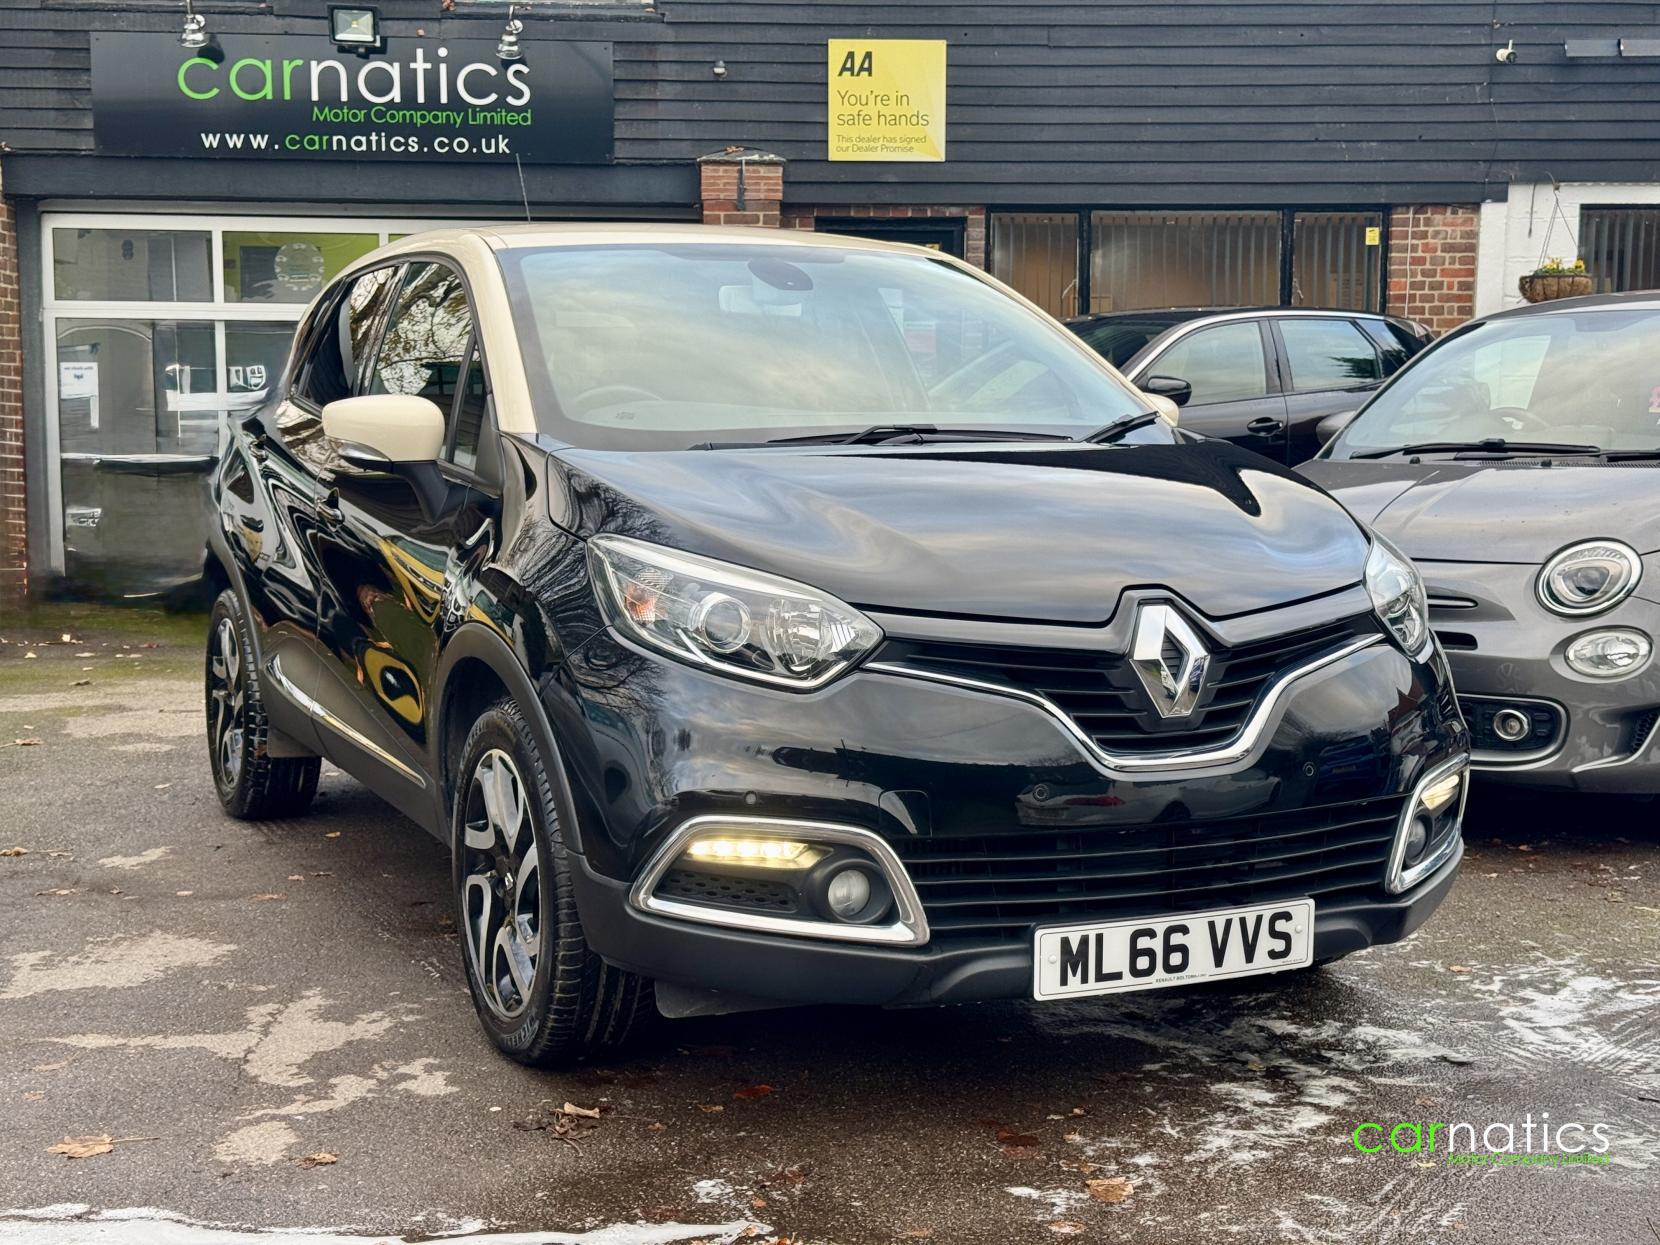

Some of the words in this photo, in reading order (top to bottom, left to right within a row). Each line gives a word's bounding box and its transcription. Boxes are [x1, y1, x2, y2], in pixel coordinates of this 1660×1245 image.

[837, 51, 873, 77] AA
[176, 47, 532, 106] carnatics
[836, 89, 891, 107] You're
[895, 90, 910, 107] in
[311, 106, 368, 123] Motor
[371, 106, 464, 128] Company
[467, 108, 532, 126] Limited
[836, 109, 873, 127] safe
[877, 109, 930, 127] hands
[200, 131, 511, 154] www.carnatics.co.uk
[835, 145, 850, 153] our
[851, 143, 879, 153] Dealer
[880, 143, 915, 153] Promise
[836, 134, 854, 144] This
[854, 134, 881, 144] dealer
[882, 134, 898, 144] has
[899, 134, 927, 145] signed
[1059, 923, 1190, 987] ML66
[1207, 910, 1294, 969] VVS
